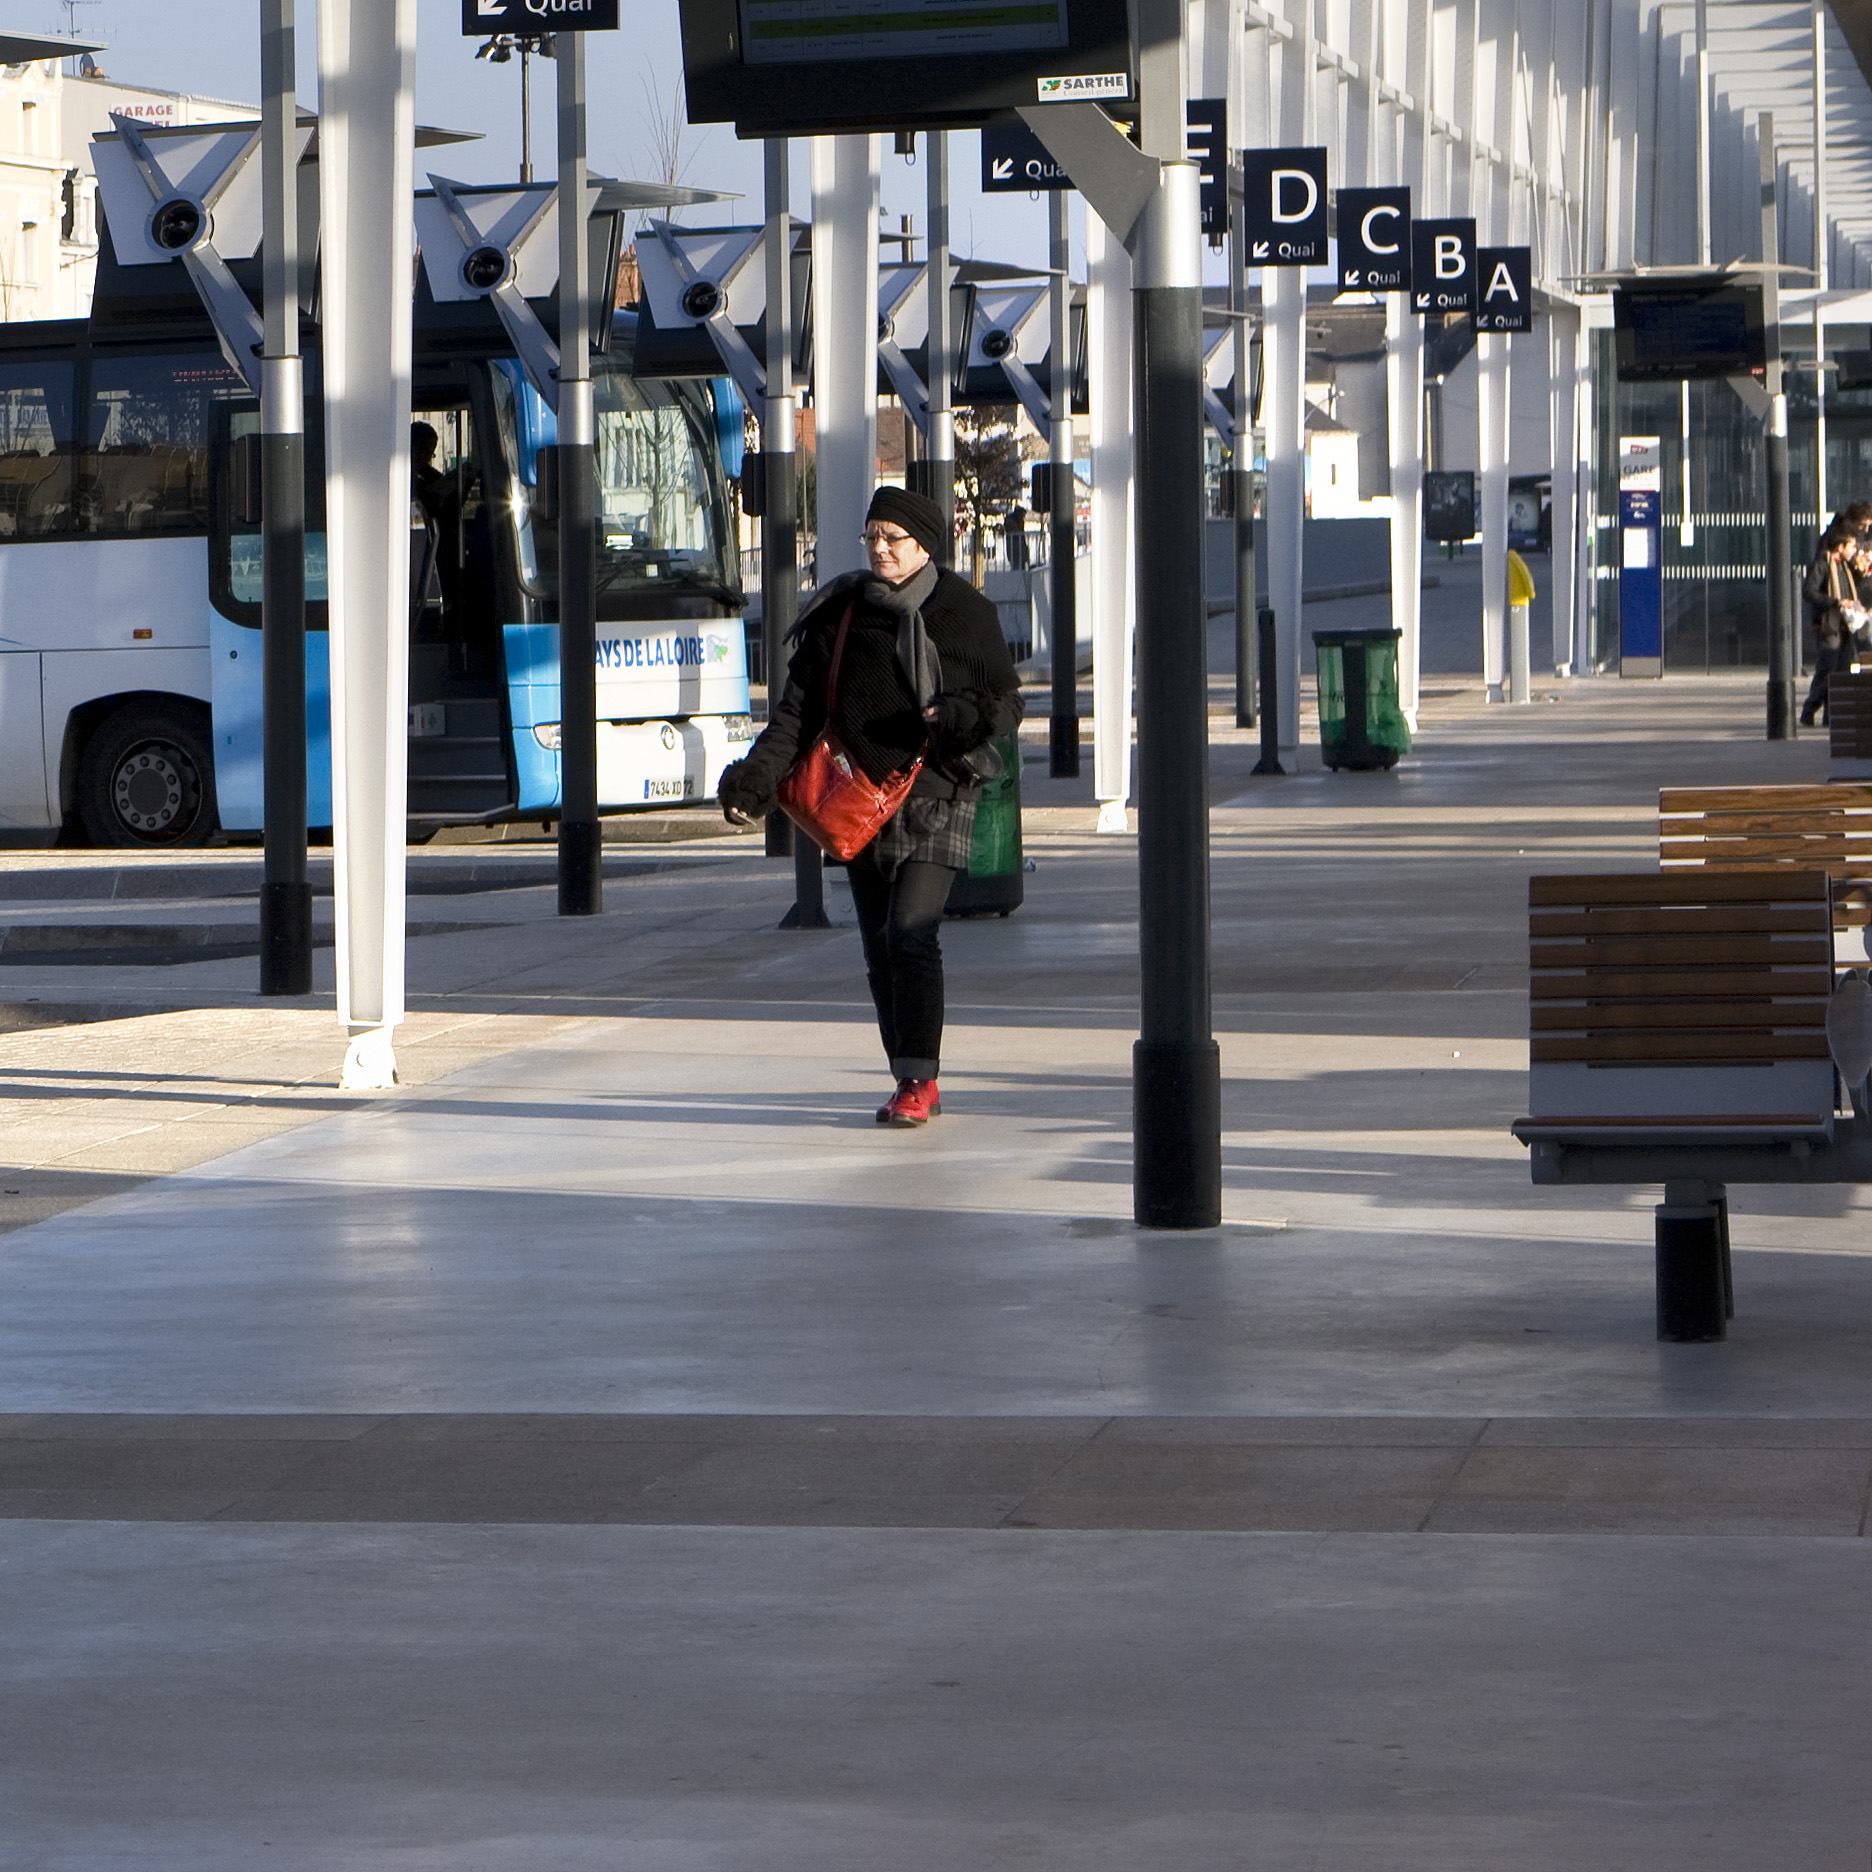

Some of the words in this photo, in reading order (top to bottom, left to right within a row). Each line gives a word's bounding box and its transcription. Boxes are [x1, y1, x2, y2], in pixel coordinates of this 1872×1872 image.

[1064, 76, 1124, 89] SARTHE
[1063, 88, 1094, 96] Conseil
[113, 104, 173, 117] GARAGE
[1025, 159, 1068, 181] Qua
[1271, 169, 1318, 224] D
[1200, 207, 1213, 222] ai
[1361, 205, 1400, 255] C
[1278, 242, 1316, 259] Quai
[1435, 235, 1466, 279] B
[1367, 270, 1400, 287] Quai
[1485, 262, 1519, 303] A
[1437, 294, 1467, 308] Quai
[1495, 314, 1523, 328] Quai
[596, 639, 622, 668] AYS
[623, 639, 643, 667] DE
[646, 638, 665, 666] LA
[666, 636, 705, 666] LOIRE
[650, 780, 670, 796] 7434
[672, 780, 681, 795] XD
[684, 779, 694, 795] 72
